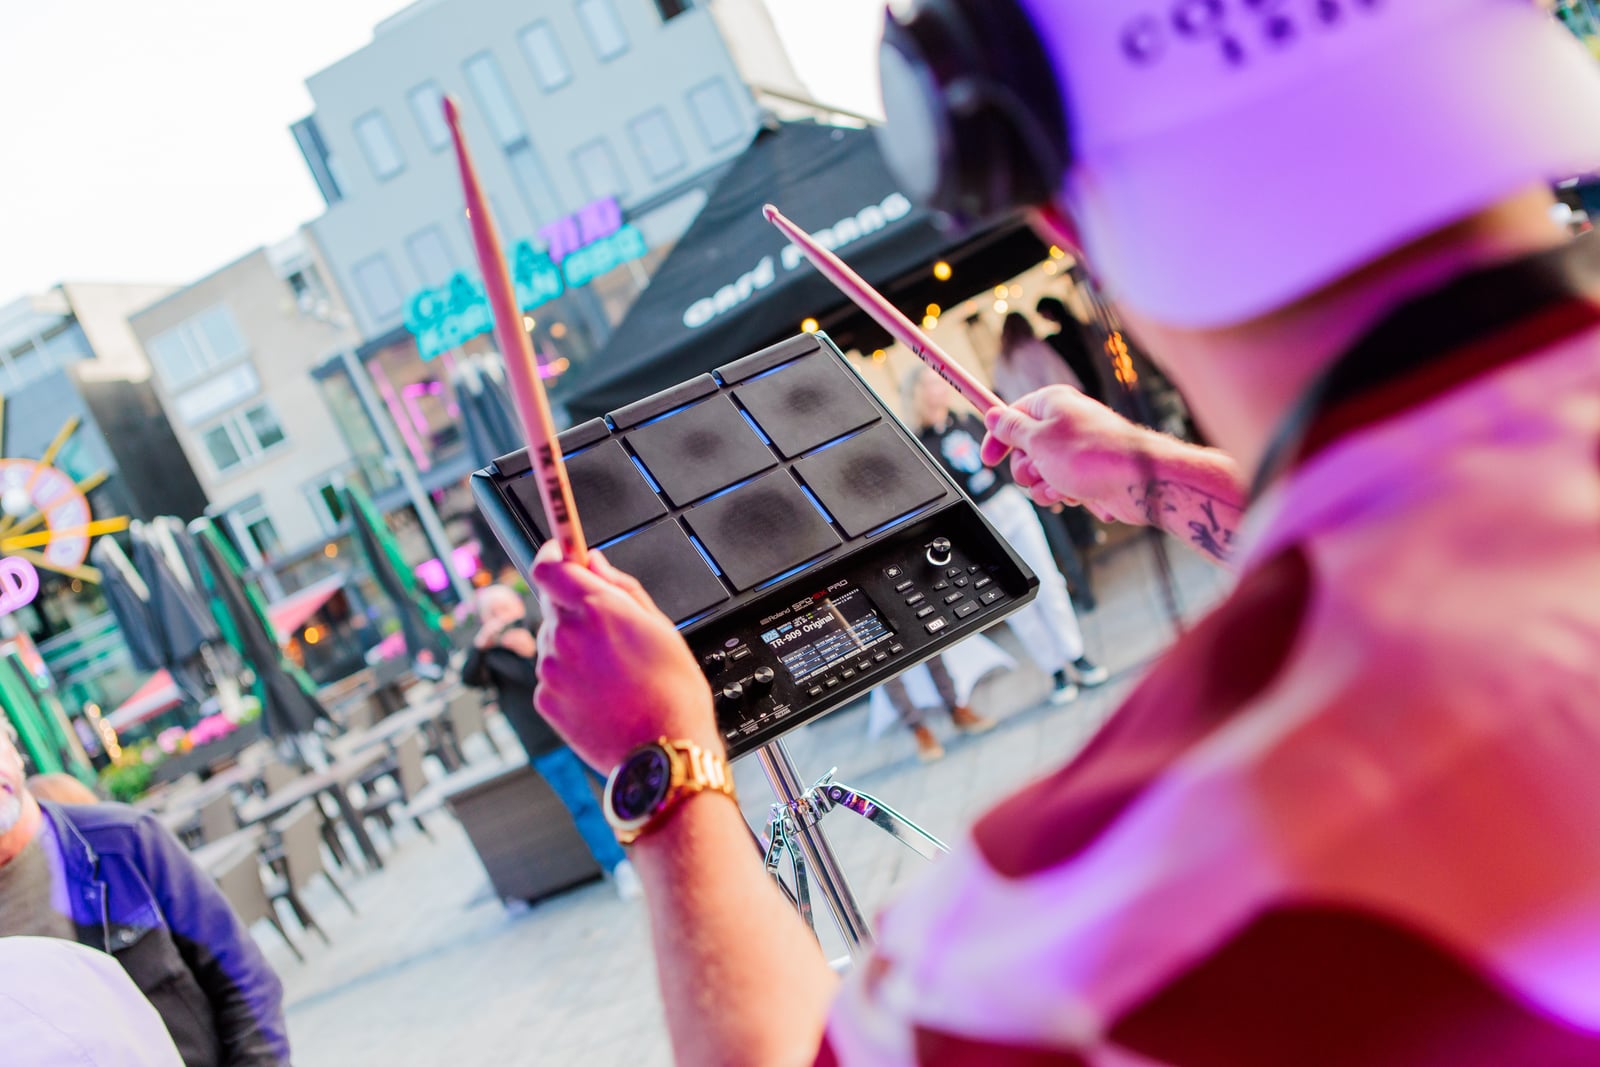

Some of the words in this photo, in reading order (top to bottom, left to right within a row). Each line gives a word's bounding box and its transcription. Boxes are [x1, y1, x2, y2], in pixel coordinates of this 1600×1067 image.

[768, 607, 791, 621] Roland
[827, 579, 848, 592] PRO
[769, 628, 803, 648] TR-909
[802, 612, 836, 633] Original
